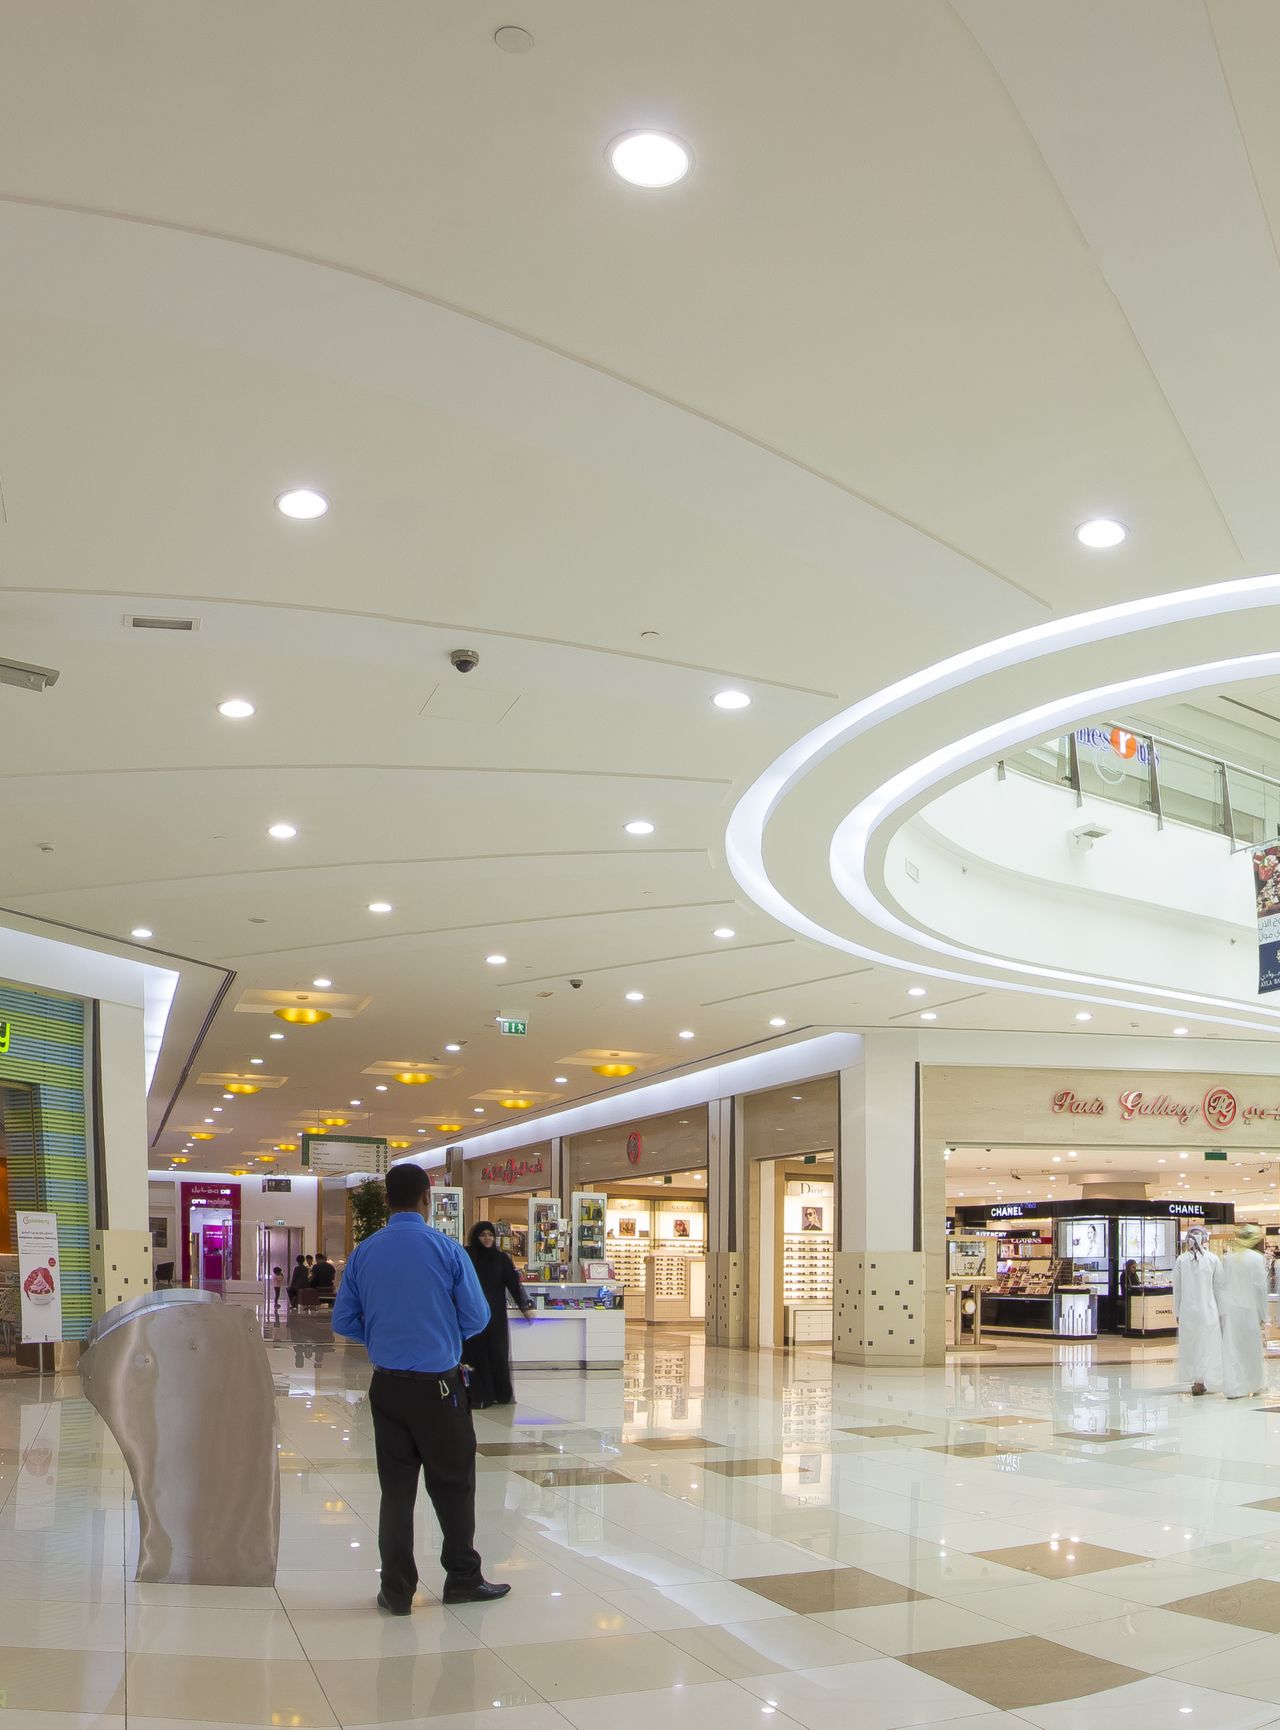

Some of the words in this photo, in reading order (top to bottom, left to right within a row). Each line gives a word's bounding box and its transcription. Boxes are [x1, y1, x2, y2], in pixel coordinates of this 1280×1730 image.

[1052, 1090, 1106, 1115] Paris
[1120, 1089, 1201, 1125] Gallery
[800, 1182, 824, 1195] Dior
[991, 1206, 1023, 1217] CHANEL
[1168, 1204, 1205, 1215] CHANEL
